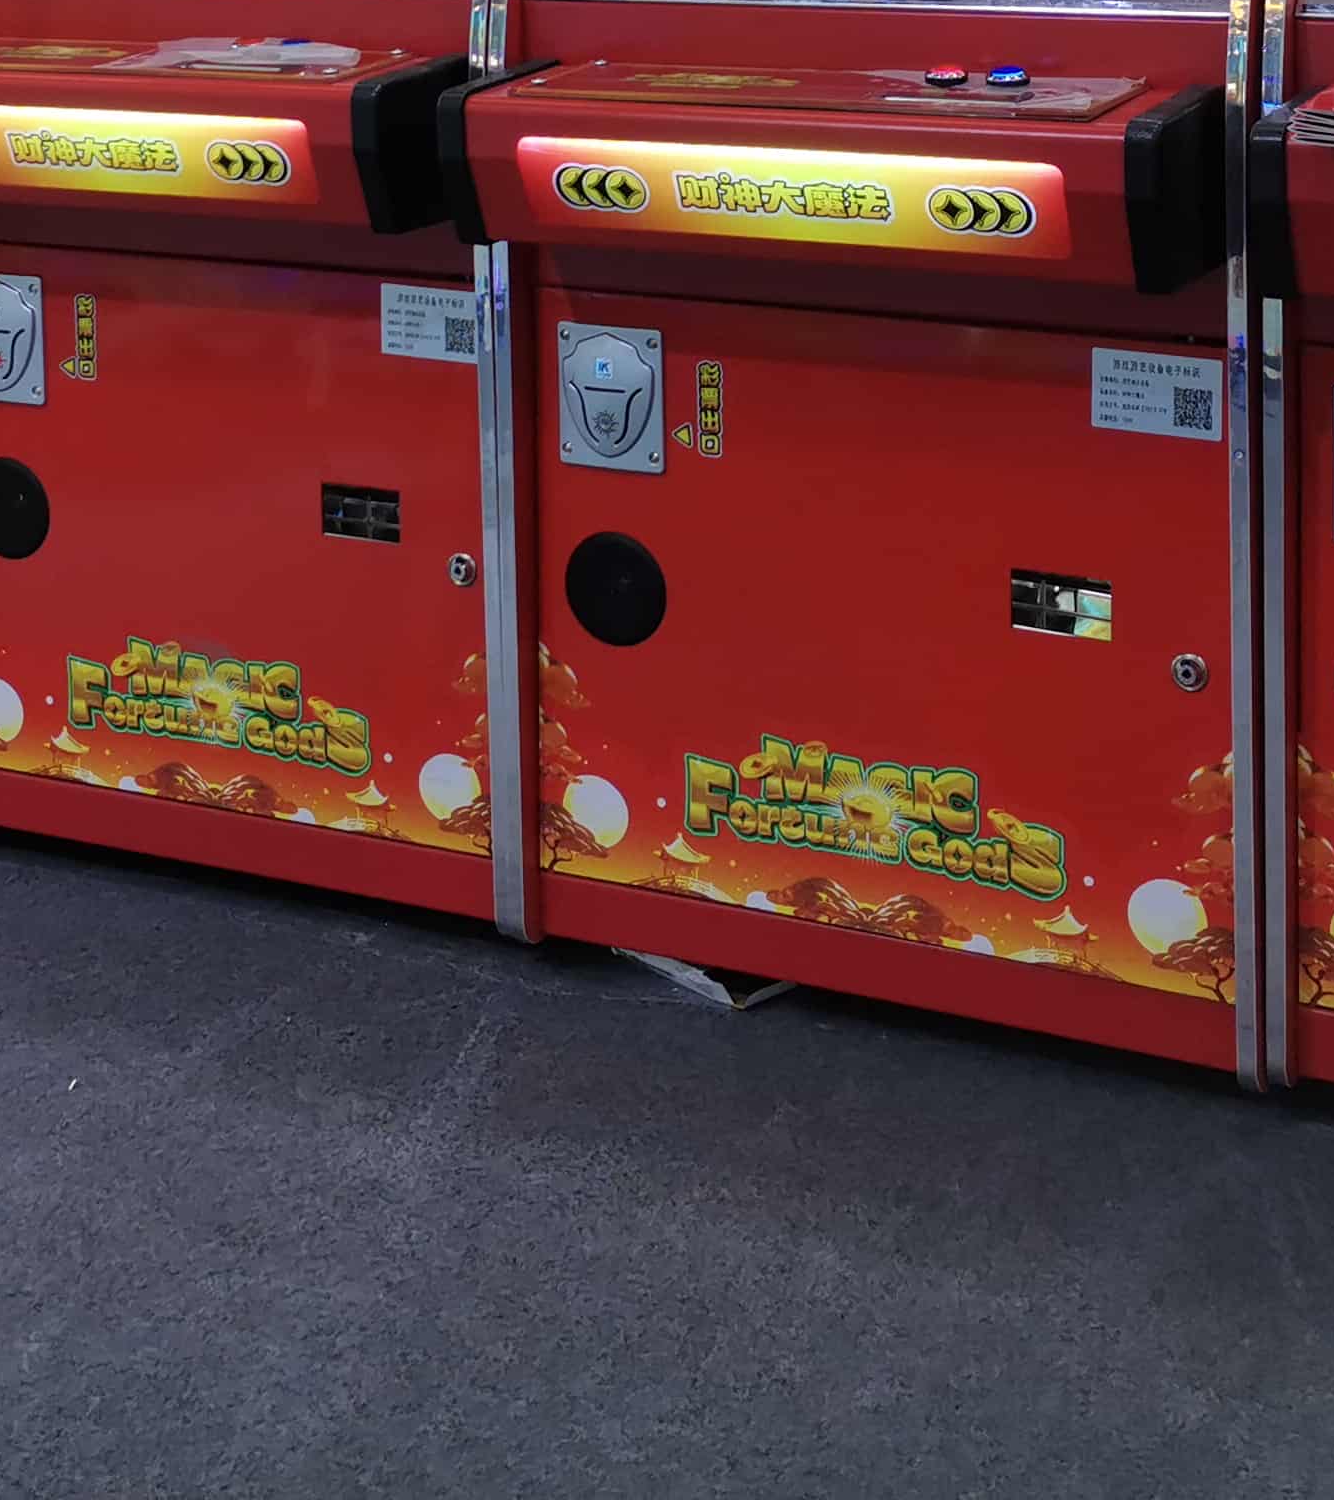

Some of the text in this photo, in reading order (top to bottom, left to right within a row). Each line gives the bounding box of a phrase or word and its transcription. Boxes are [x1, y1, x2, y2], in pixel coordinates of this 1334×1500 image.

[9, 130, 179, 173] 财神大魔法
[677, 172, 891, 221] 财神大魔法
[697, 359, 723, 458] 彩票出口
